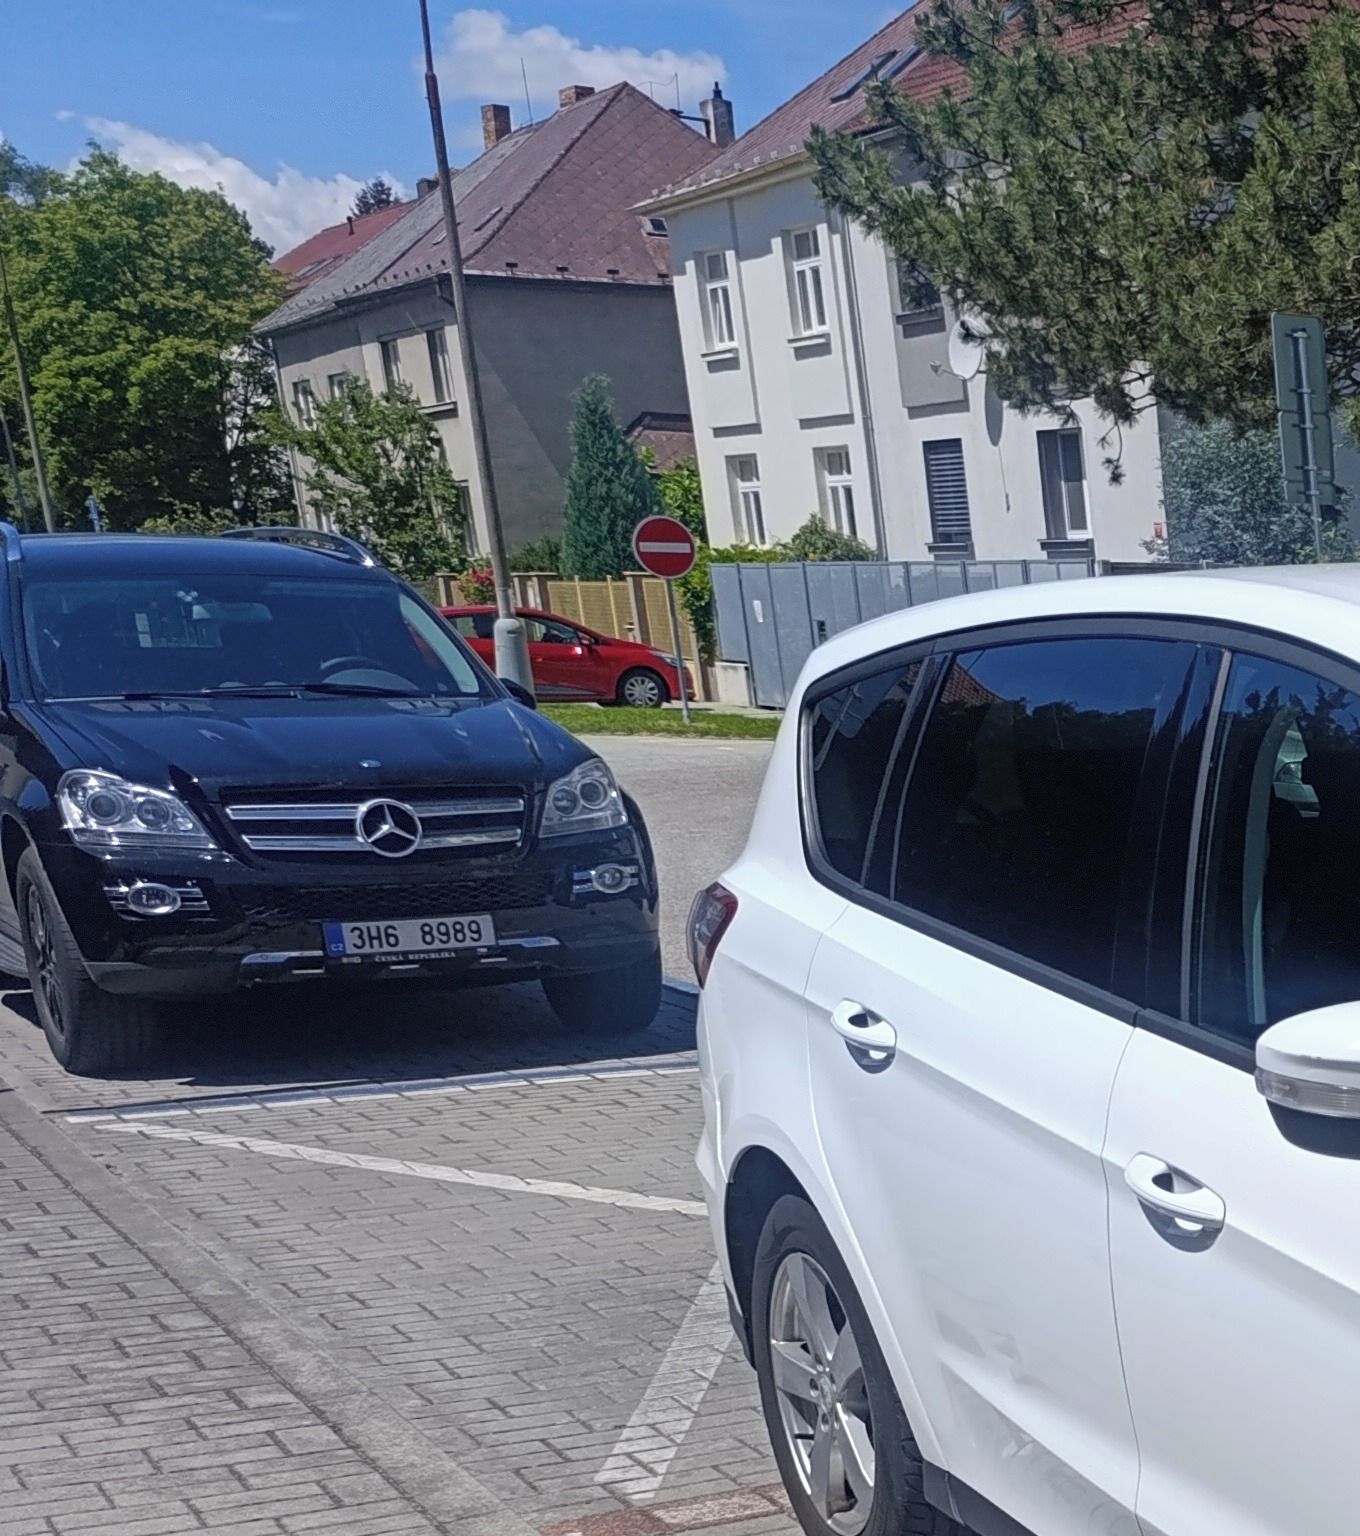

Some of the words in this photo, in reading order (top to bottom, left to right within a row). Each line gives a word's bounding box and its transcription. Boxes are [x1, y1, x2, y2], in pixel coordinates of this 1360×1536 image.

[350, 924, 400, 950] 3H6
[420, 919, 483, 946] 8989
[331, 943, 344, 952] CZ
